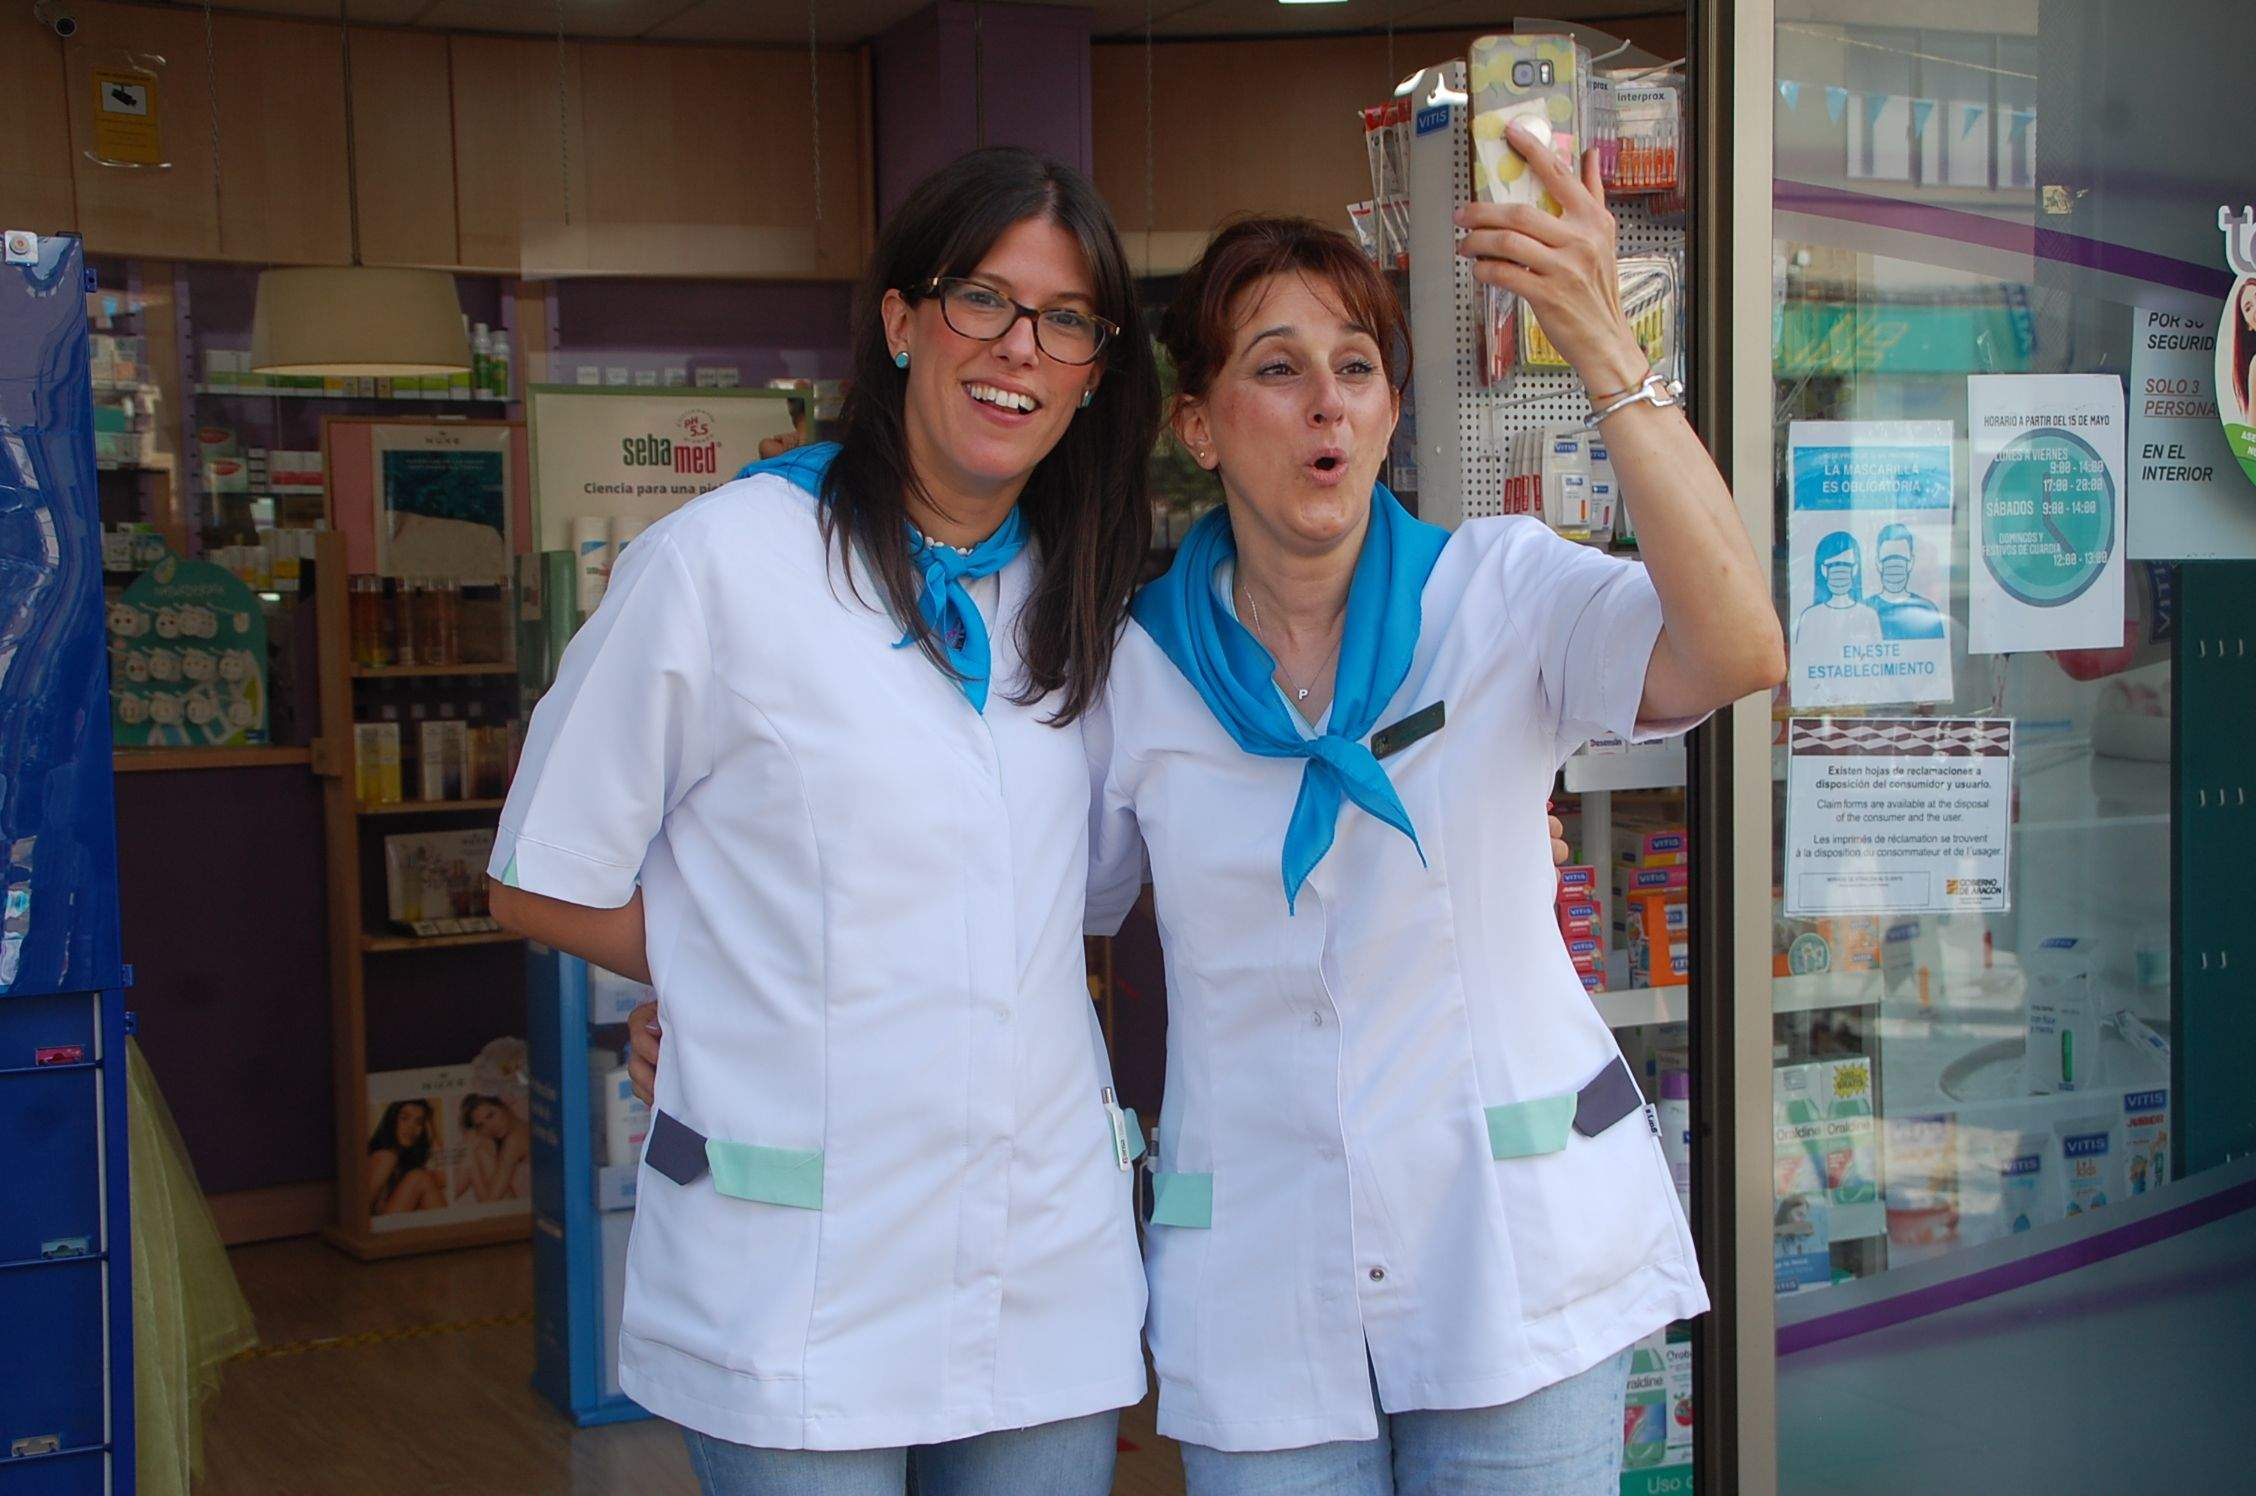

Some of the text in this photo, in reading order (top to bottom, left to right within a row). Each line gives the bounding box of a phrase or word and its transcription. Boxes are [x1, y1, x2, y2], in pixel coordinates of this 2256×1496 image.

[1418, 110, 1448, 128] VITIS
[2147, 334, 2216, 351] SEGURID
[2145, 378, 2200, 394] SOLO 3
[1984, 415, 2110, 427] HORARIO A PARTIR DEL 15 DE MAYO
[1995, 448, 2069, 462] LUNES A VIERNES
[2142, 444, 2186, 459] EN EL
[1824, 463, 1920, 475] LA MASCARILLA
[2050, 461, 2071, 474] 9:00
[2079, 460, 2104, 473] 14:00
[2142, 465, 2214, 482] INTERIOR
[583, 482, 633, 494] Ciencia
[637, 485, 667, 497] para
[670, 485, 696, 494] una
[1822, 480, 1921, 493] ES OBLIGATORIA
[2043, 479, 2068, 492] 17:00
[2075, 478, 2104, 491] 20:00
[1986, 498, 2034, 517] SÁBADOS
[2042, 502, 2064, 515] 9:00
[2072, 501, 2097, 514] 14:00
[1999, 532, 2044, 544] DOMINGOS Y
[2018, 544, 2028, 555] DE
[2029, 543, 2061, 555] GUARDIA
[2053, 553, 2077, 567] 12:00
[2084, 551, 2108, 564] 13:00
[1843, 643, 1901, 658] EN ESTE
[1808, 661, 1935, 679] ESTABLECIMIENTO
[1298, 689, 1309, 700] P
[1828, 765, 1863, 776] Existen
[1865, 765, 1890, 777] hojas
[1893, 766, 1904, 776] de
[1907, 766, 1973, 776] reclamaciones
[1815, 779, 1991, 791] disposición del consumidor y usuario.
[1816, 799, 1989, 810] Claim forms are available at the disposal
[1835, 813, 1845, 822] of
[1846, 813, 1861, 822] the
[1862, 814, 1906, 822] consumer
[1908, 813, 1924, 822] and
[1926, 813, 1940, 822] the
[1653, 839, 1679, 849] VITIS
[1813, 834, 1830, 844] Les
[1832, 834, 1872, 845] imprimés
[1874, 835, 1886, 844] de
[1888, 834, 1938, 844] réclamation
[1953, 834, 1988, 843] trouvent
[1803, 848, 1812, 857] la
[1814, 848, 1861, 858] disposition
[1863, 848, 1874, 857] du
[1876, 848, 1940, 857] consommateur
[1942, 848, 1952, 856] et
[1953, 847, 1965, 856] de
[1563, 873, 1586, 881] VITIS
[1640, 873, 1667, 883] VITIS
[2126, 1092, 2164, 1108] VITIS
[2066, 1138, 2106, 1153] VITIS
[1647, 1475, 1681, 1495] Uso
